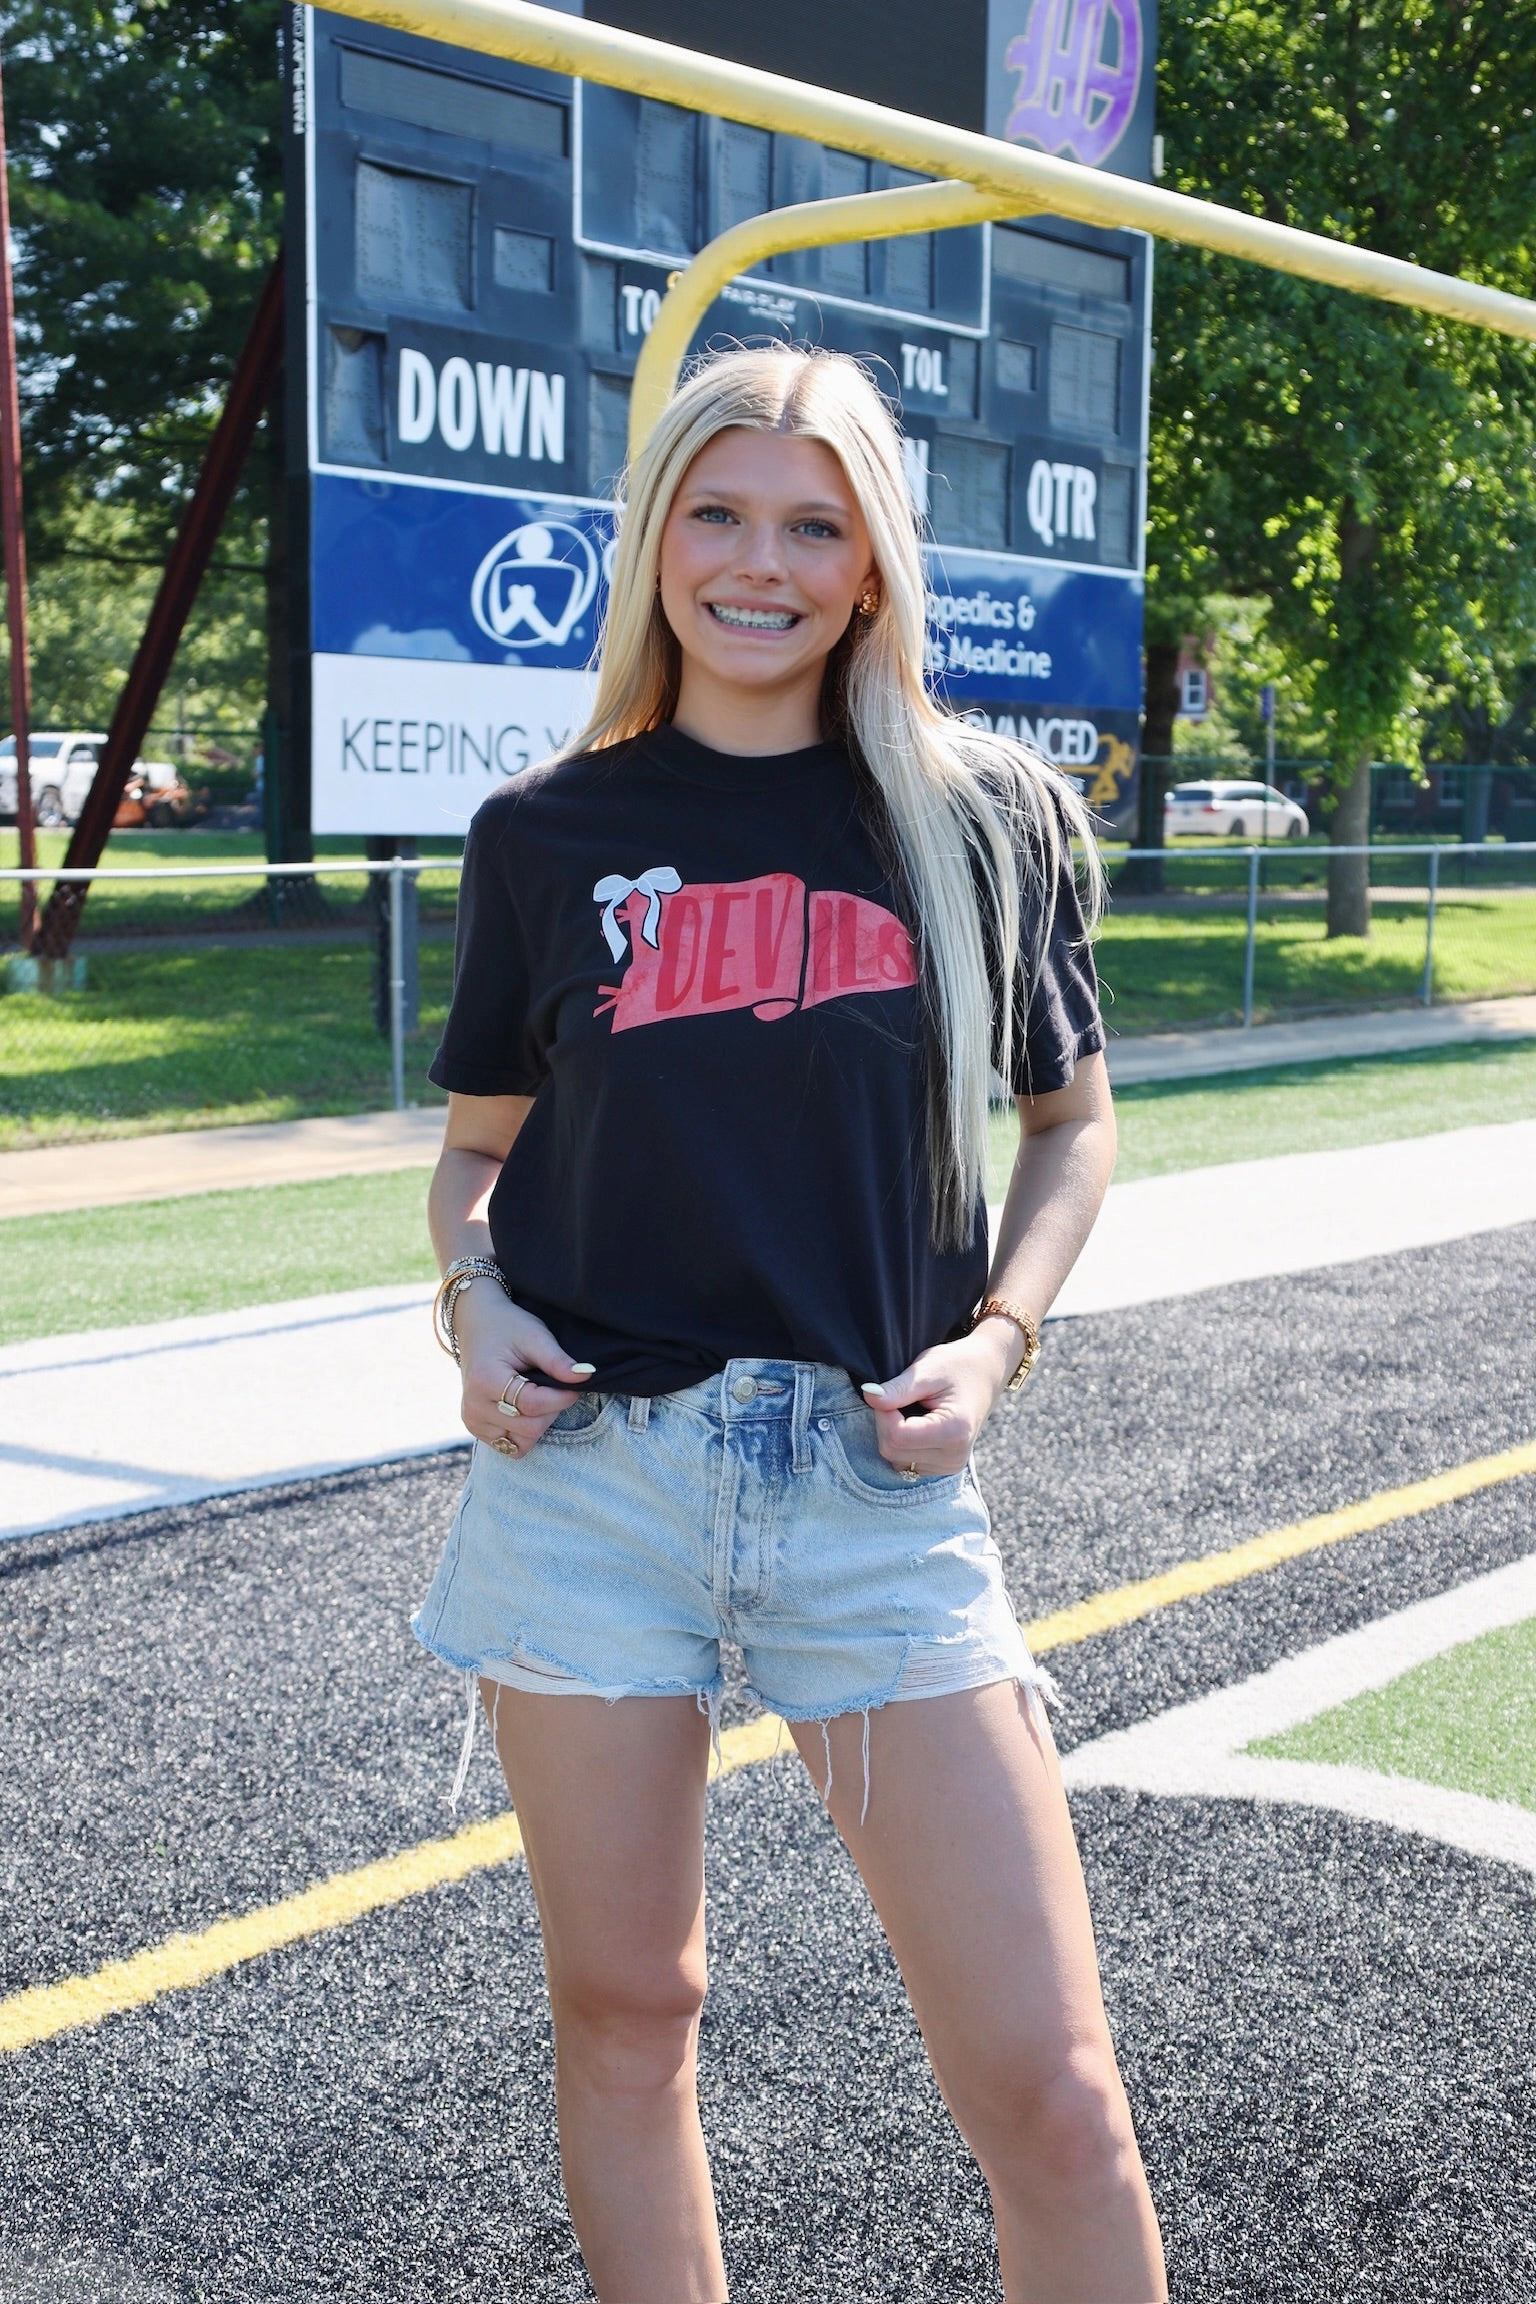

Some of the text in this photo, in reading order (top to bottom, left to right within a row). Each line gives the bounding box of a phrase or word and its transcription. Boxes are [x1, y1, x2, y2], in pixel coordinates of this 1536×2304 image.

[622, 285, 662, 337] TO
[901, 343, 948, 396] TOL
[399, 347, 565, 464] DOWN
[1027, 459, 1097, 546] QTR
[926, 589, 1037, 631] opedics &
[949, 635, 1052, 679] Medicine
[342, 718, 530, 776] KEEPING
[655, 883, 913, 1012] DEVILS
